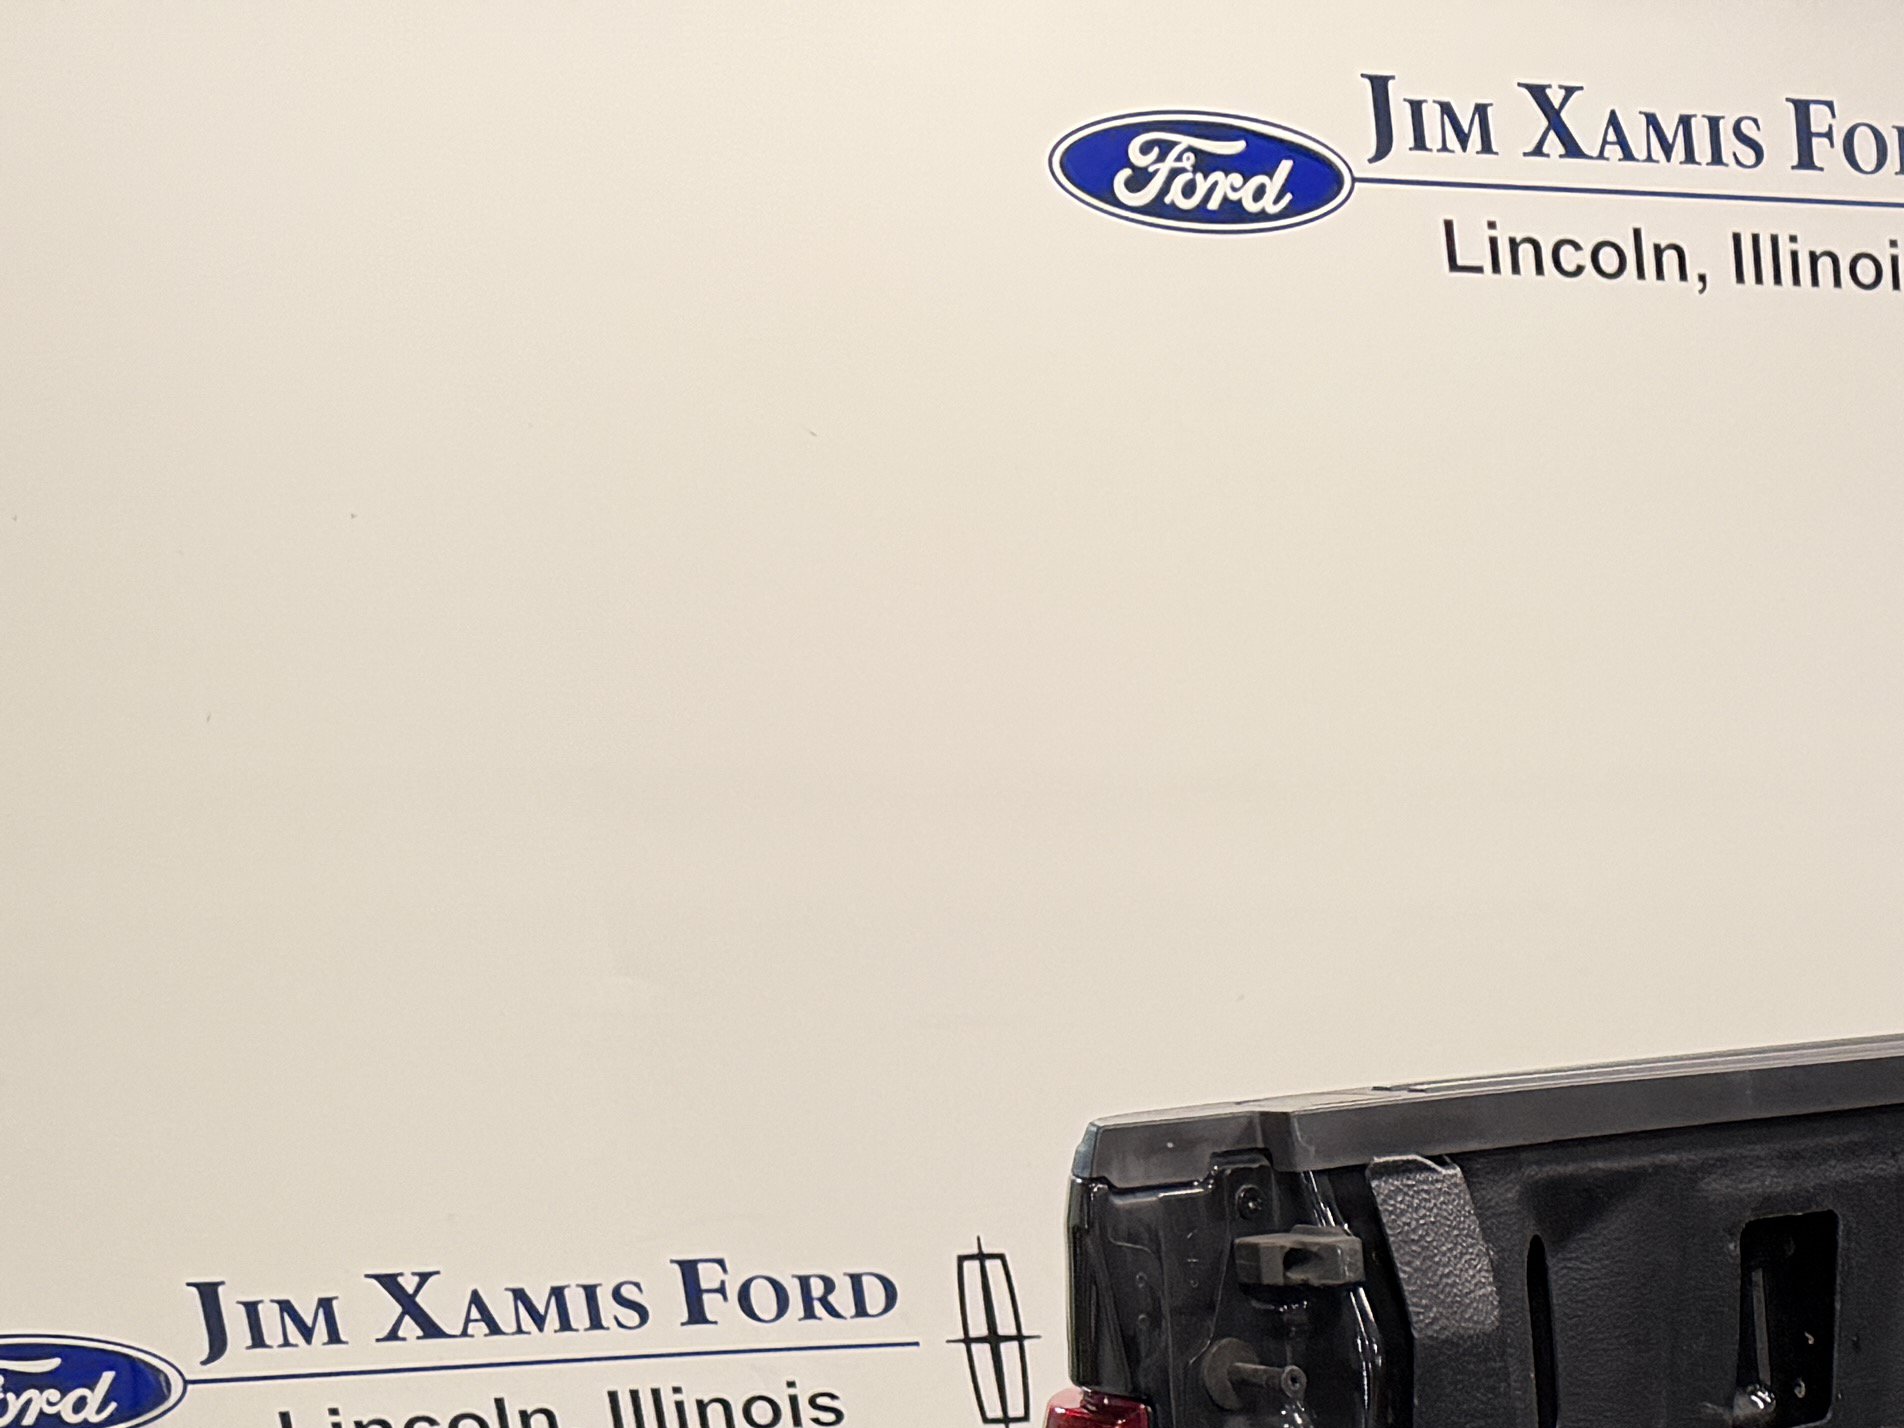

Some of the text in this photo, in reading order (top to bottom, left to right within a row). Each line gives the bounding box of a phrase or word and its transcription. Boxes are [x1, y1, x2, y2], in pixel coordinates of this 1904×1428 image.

[1360, 73, 1499, 164] JIM
[1516, 81, 1765, 169] XAMIS
[1112, 131, 1294, 214] Ford
[1443, 218, 1707, 295] Lincoln,
[185, 1257, 898, 1366] JIM XAMIS FORD
[0, 1356, 118, 1428] ord
